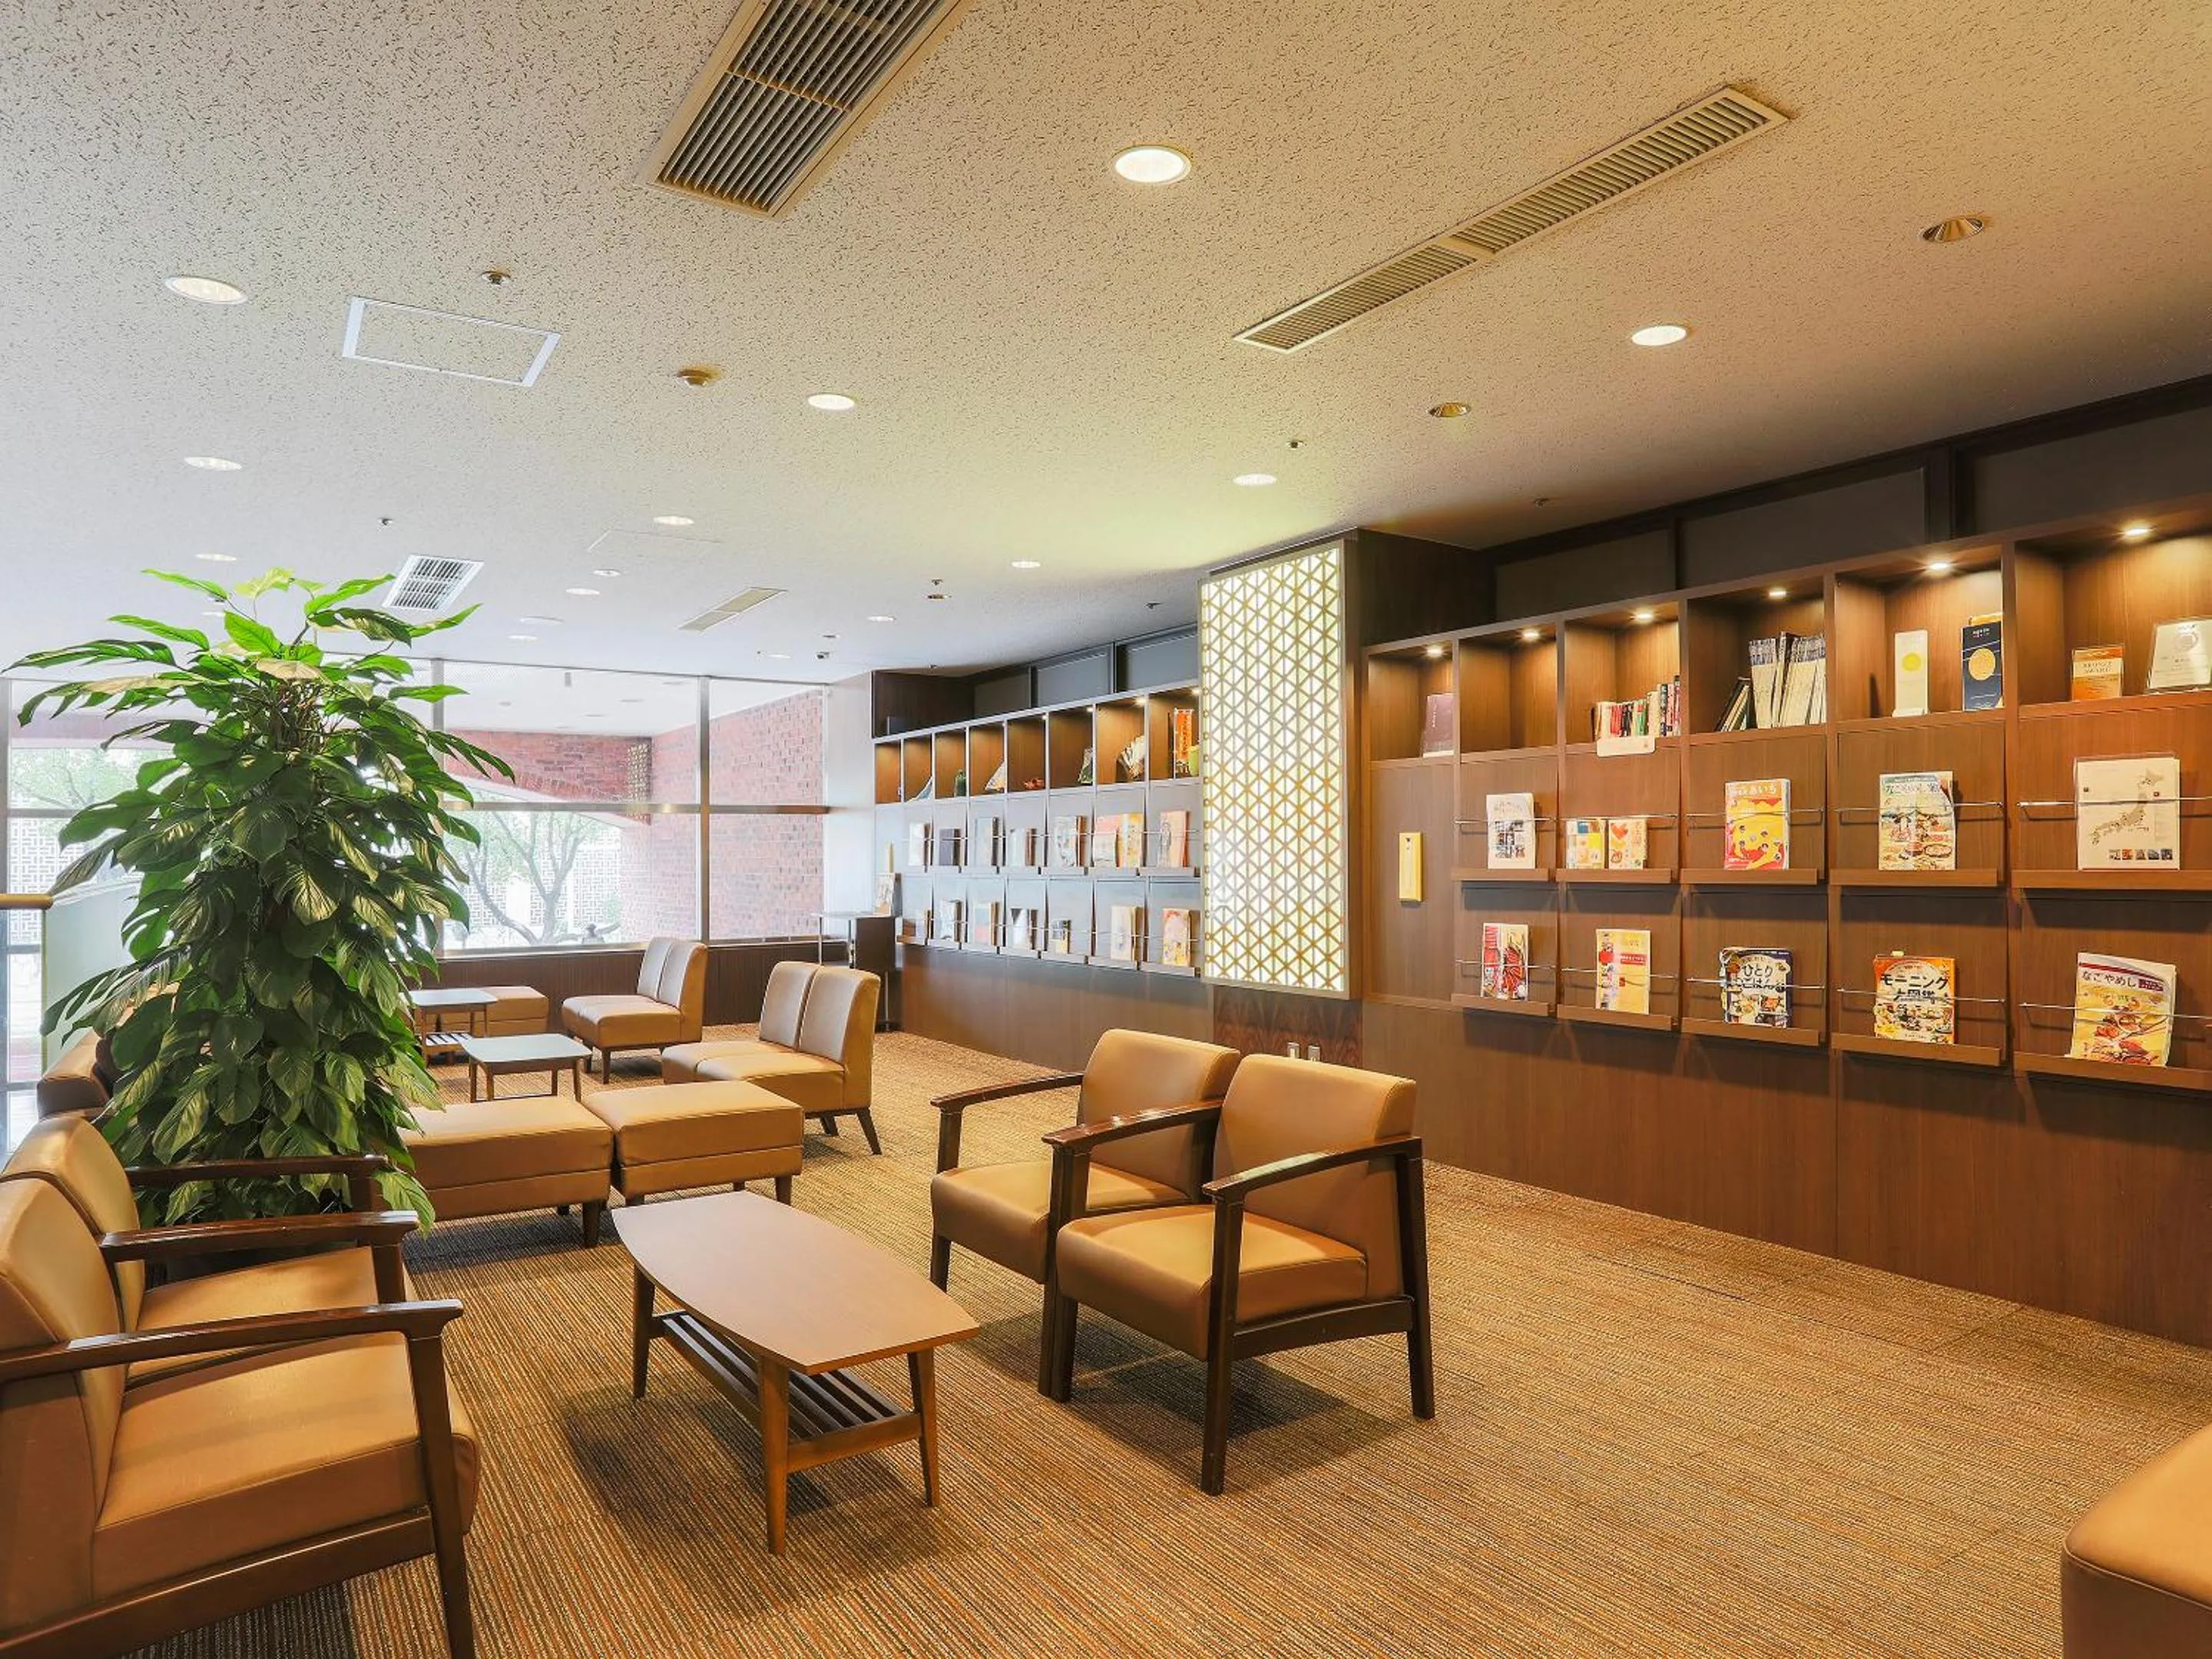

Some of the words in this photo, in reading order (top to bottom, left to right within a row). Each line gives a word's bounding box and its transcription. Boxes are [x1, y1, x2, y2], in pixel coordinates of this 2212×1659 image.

[1741, 964, 1773, 978] ひとり
[2081, 971, 2136, 988] なごやめし
[1879, 972, 1949, 990] モーニング
